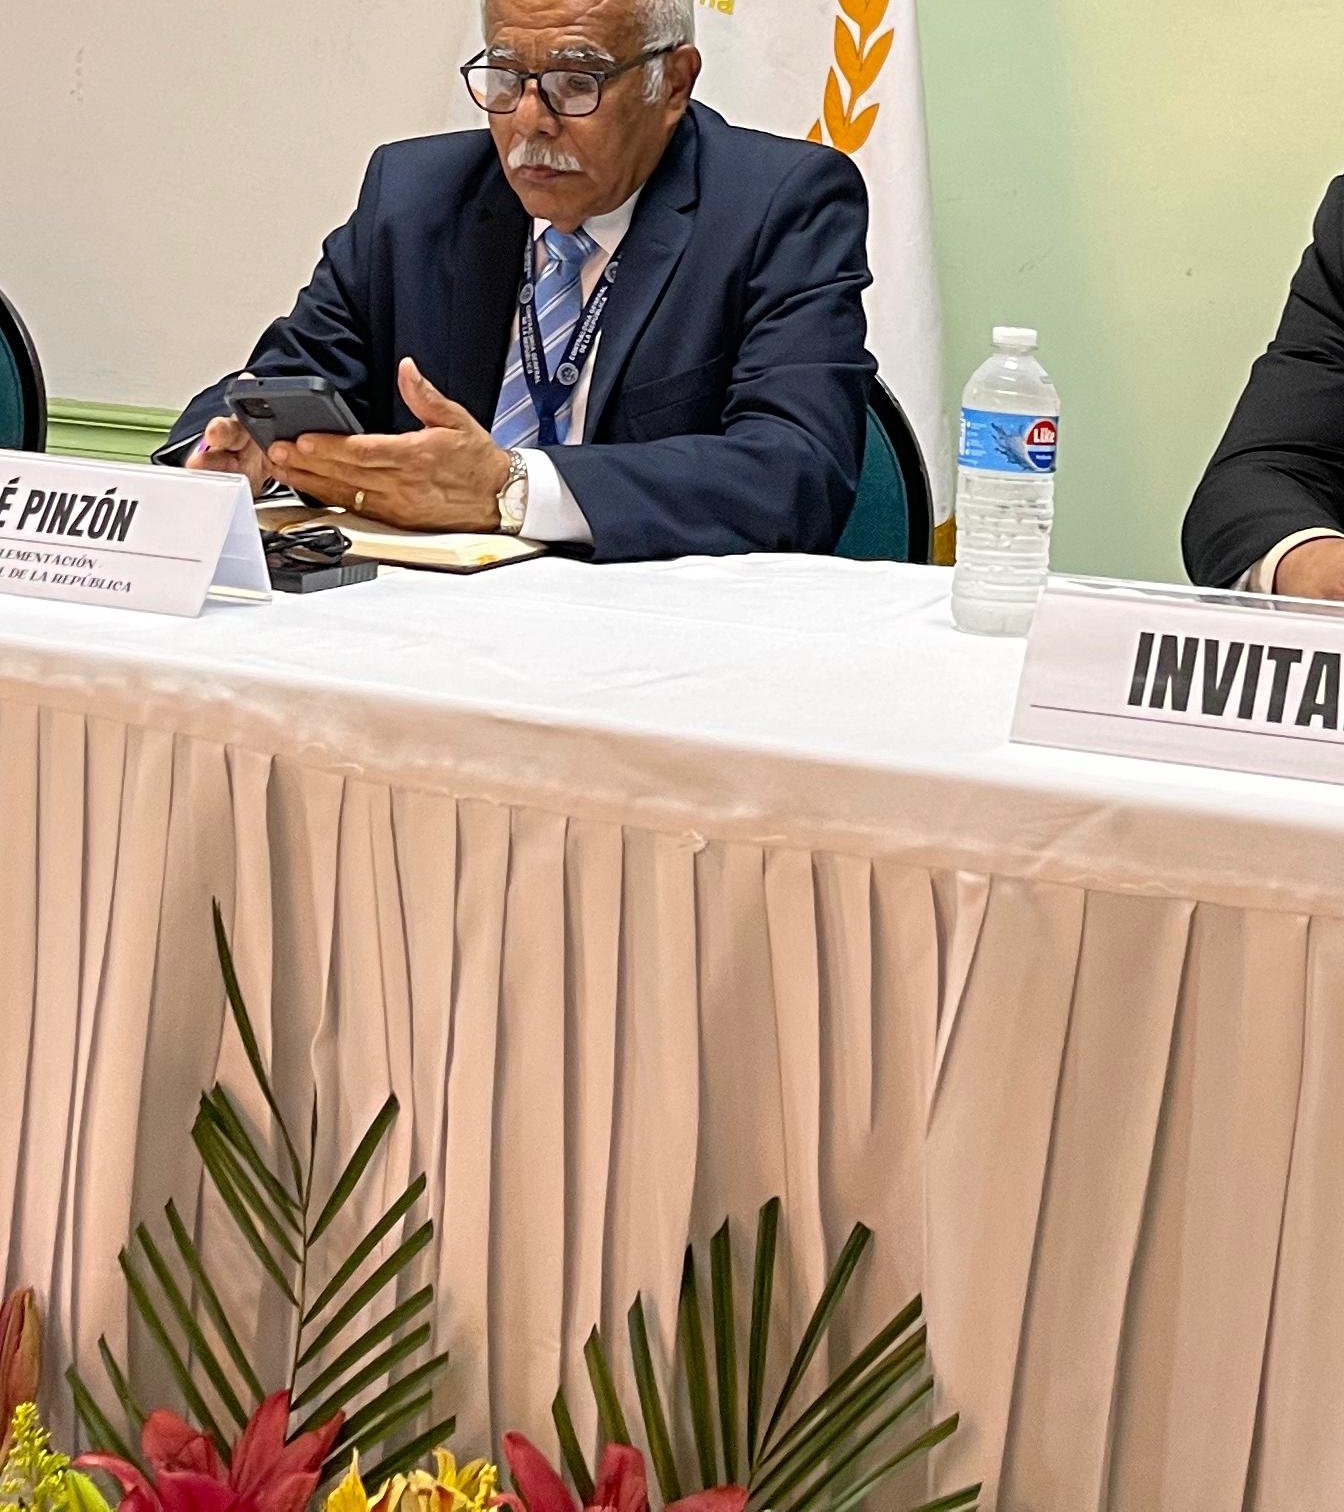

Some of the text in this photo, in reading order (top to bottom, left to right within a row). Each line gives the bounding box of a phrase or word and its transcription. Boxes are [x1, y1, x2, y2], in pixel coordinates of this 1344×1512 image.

[16, 486, 140, 542] PINZÓN
[8, 567, 28, 580] DE
[29, 570, 49, 583] LA
[51, 568, 132, 593] REPÚBLICA
